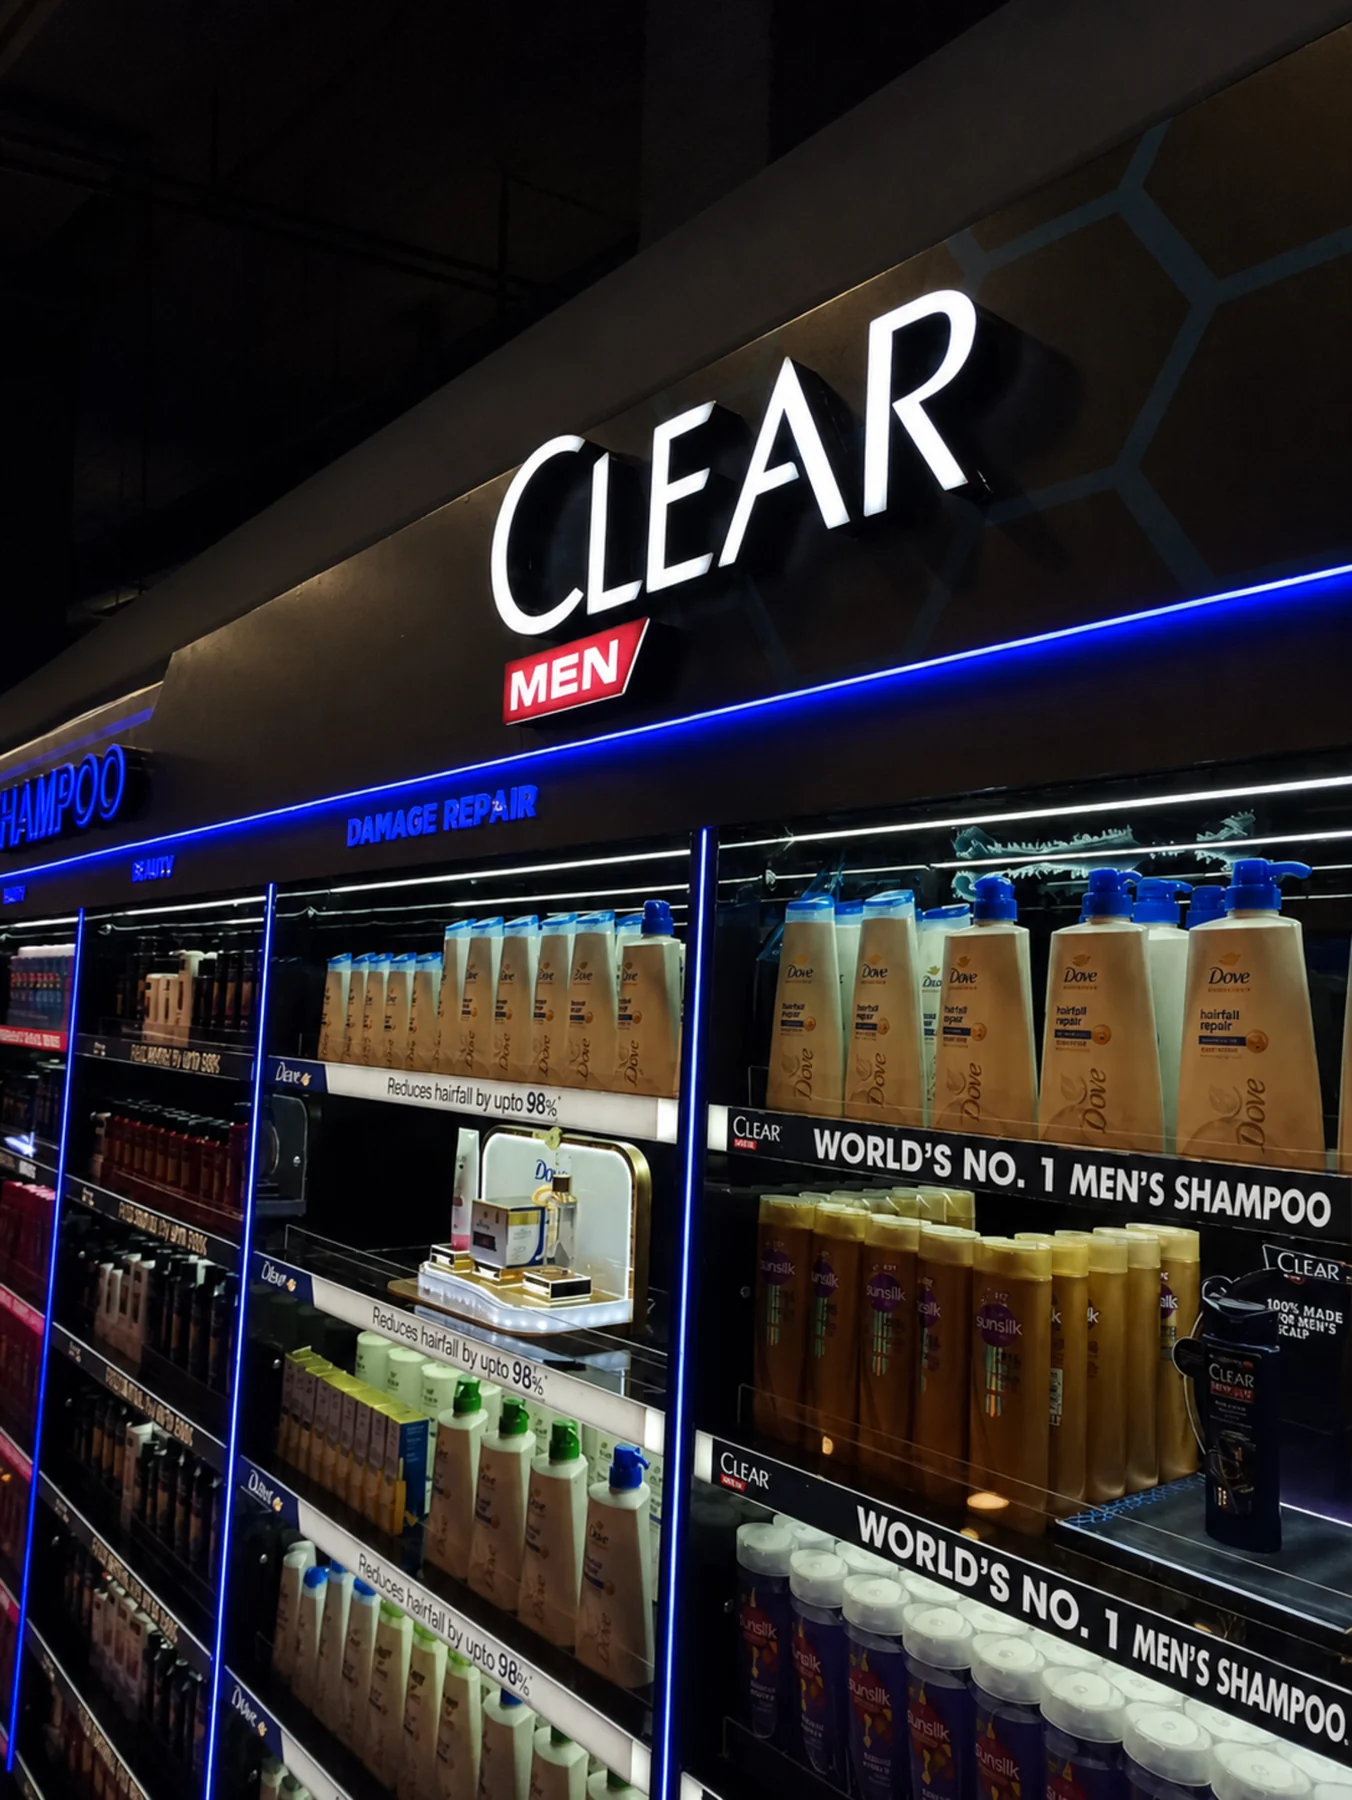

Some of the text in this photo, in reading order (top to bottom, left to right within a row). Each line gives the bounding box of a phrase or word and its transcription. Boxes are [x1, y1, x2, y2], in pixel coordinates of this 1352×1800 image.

[491, 289, 977, 635] CLEAR
[509, 639, 620, 712] MEN
[346, 784, 539, 848] DAMAGE REPAIR
[787, 965, 814, 978] Dove
[862, 965, 888, 978] Dove
[950, 968, 978, 984] Dove
[1064, 967, 1098, 983] Dove
[1209, 967, 1251, 985] Dove
[1056, 1006, 1087, 1016] hairfall
[1200, 1009, 1239, 1020] hairfall
[1200, 1021, 1232, 1033] repair
[794, 1048, 814, 1101] Dove
[867, 1053, 887, 1108] Dove
[388, 1077, 432, 1100] Reduces
[434, 1084, 473, 1105] hairfall
[476, 1091, 491, 1112] by
[494, 1097, 523, 1115] upto
[960, 1063, 982, 1122] Dove
[1082, 1068, 1107, 1134] Dove
[733, 1115, 780, 1143] CLEAR
[1236, 1078, 1266, 1154] Dove
[813, 1128, 1332, 1228] WORLD'S NO. 1 MEN'S SHAMPOO
[1277, 1252, 1340, 1281] CLEAR
[866, 1285, 906, 1301] sunsilk
[975, 1315, 1022, 1336] sunsilk
[1266, 1298, 1344, 1324] 100% MADE
[1298, 1315, 1337, 1335] MEN'S
[372, 1306, 418, 1342] Reduces
[421, 1325, 459, 1358] hairfall
[462, 1343, 477, 1366] by
[480, 1355, 509, 1379] upto
[1208, 1363, 1255, 1388] CLEAR
[719, 1451, 769, 1490] CLEAR
[359, 1553, 404, 1604] Reduces
[406, 1587, 445, 1632] hairfall
[448, 1615, 463, 1648] by
[466, 1636, 495, 1671] upto
[857, 1504, 1351, 1747] WORLD'S NO. 1 MEN'S SHAMPOO.
[847, 1677, 891, 1707] sunsilk
[907, 1709, 951, 1743] sunsilk
[975, 1743, 1021, 1780] sunsilk
